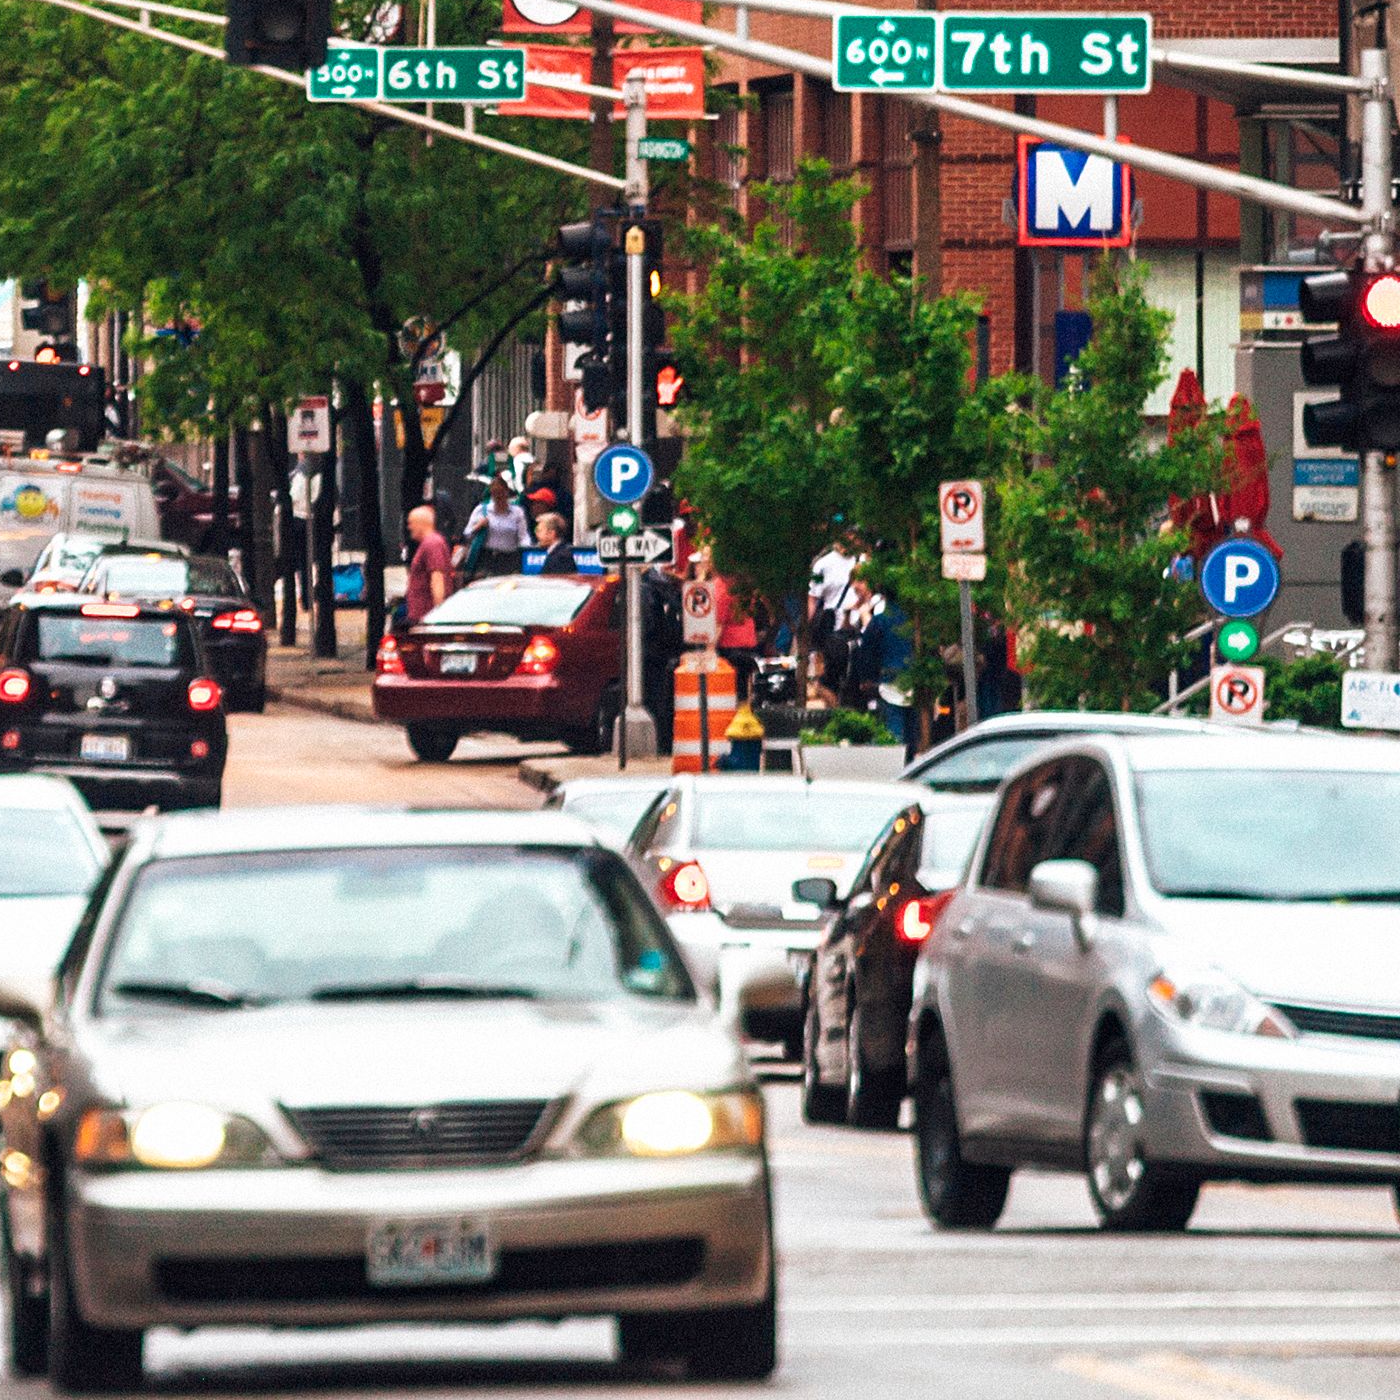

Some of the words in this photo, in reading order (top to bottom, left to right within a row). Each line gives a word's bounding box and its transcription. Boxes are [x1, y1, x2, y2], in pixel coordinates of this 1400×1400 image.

[846, 38, 913, 65] 600
[950, 31, 1050, 75] 7th
[1080, 31, 1140, 75] St
[388, 59, 457, 89] 6th
[477, 59, 520, 89] St
[1034, 150, 1114, 230] M
[602, 538, 621, 555] ON
[633, 538, 659, 553] WAY
